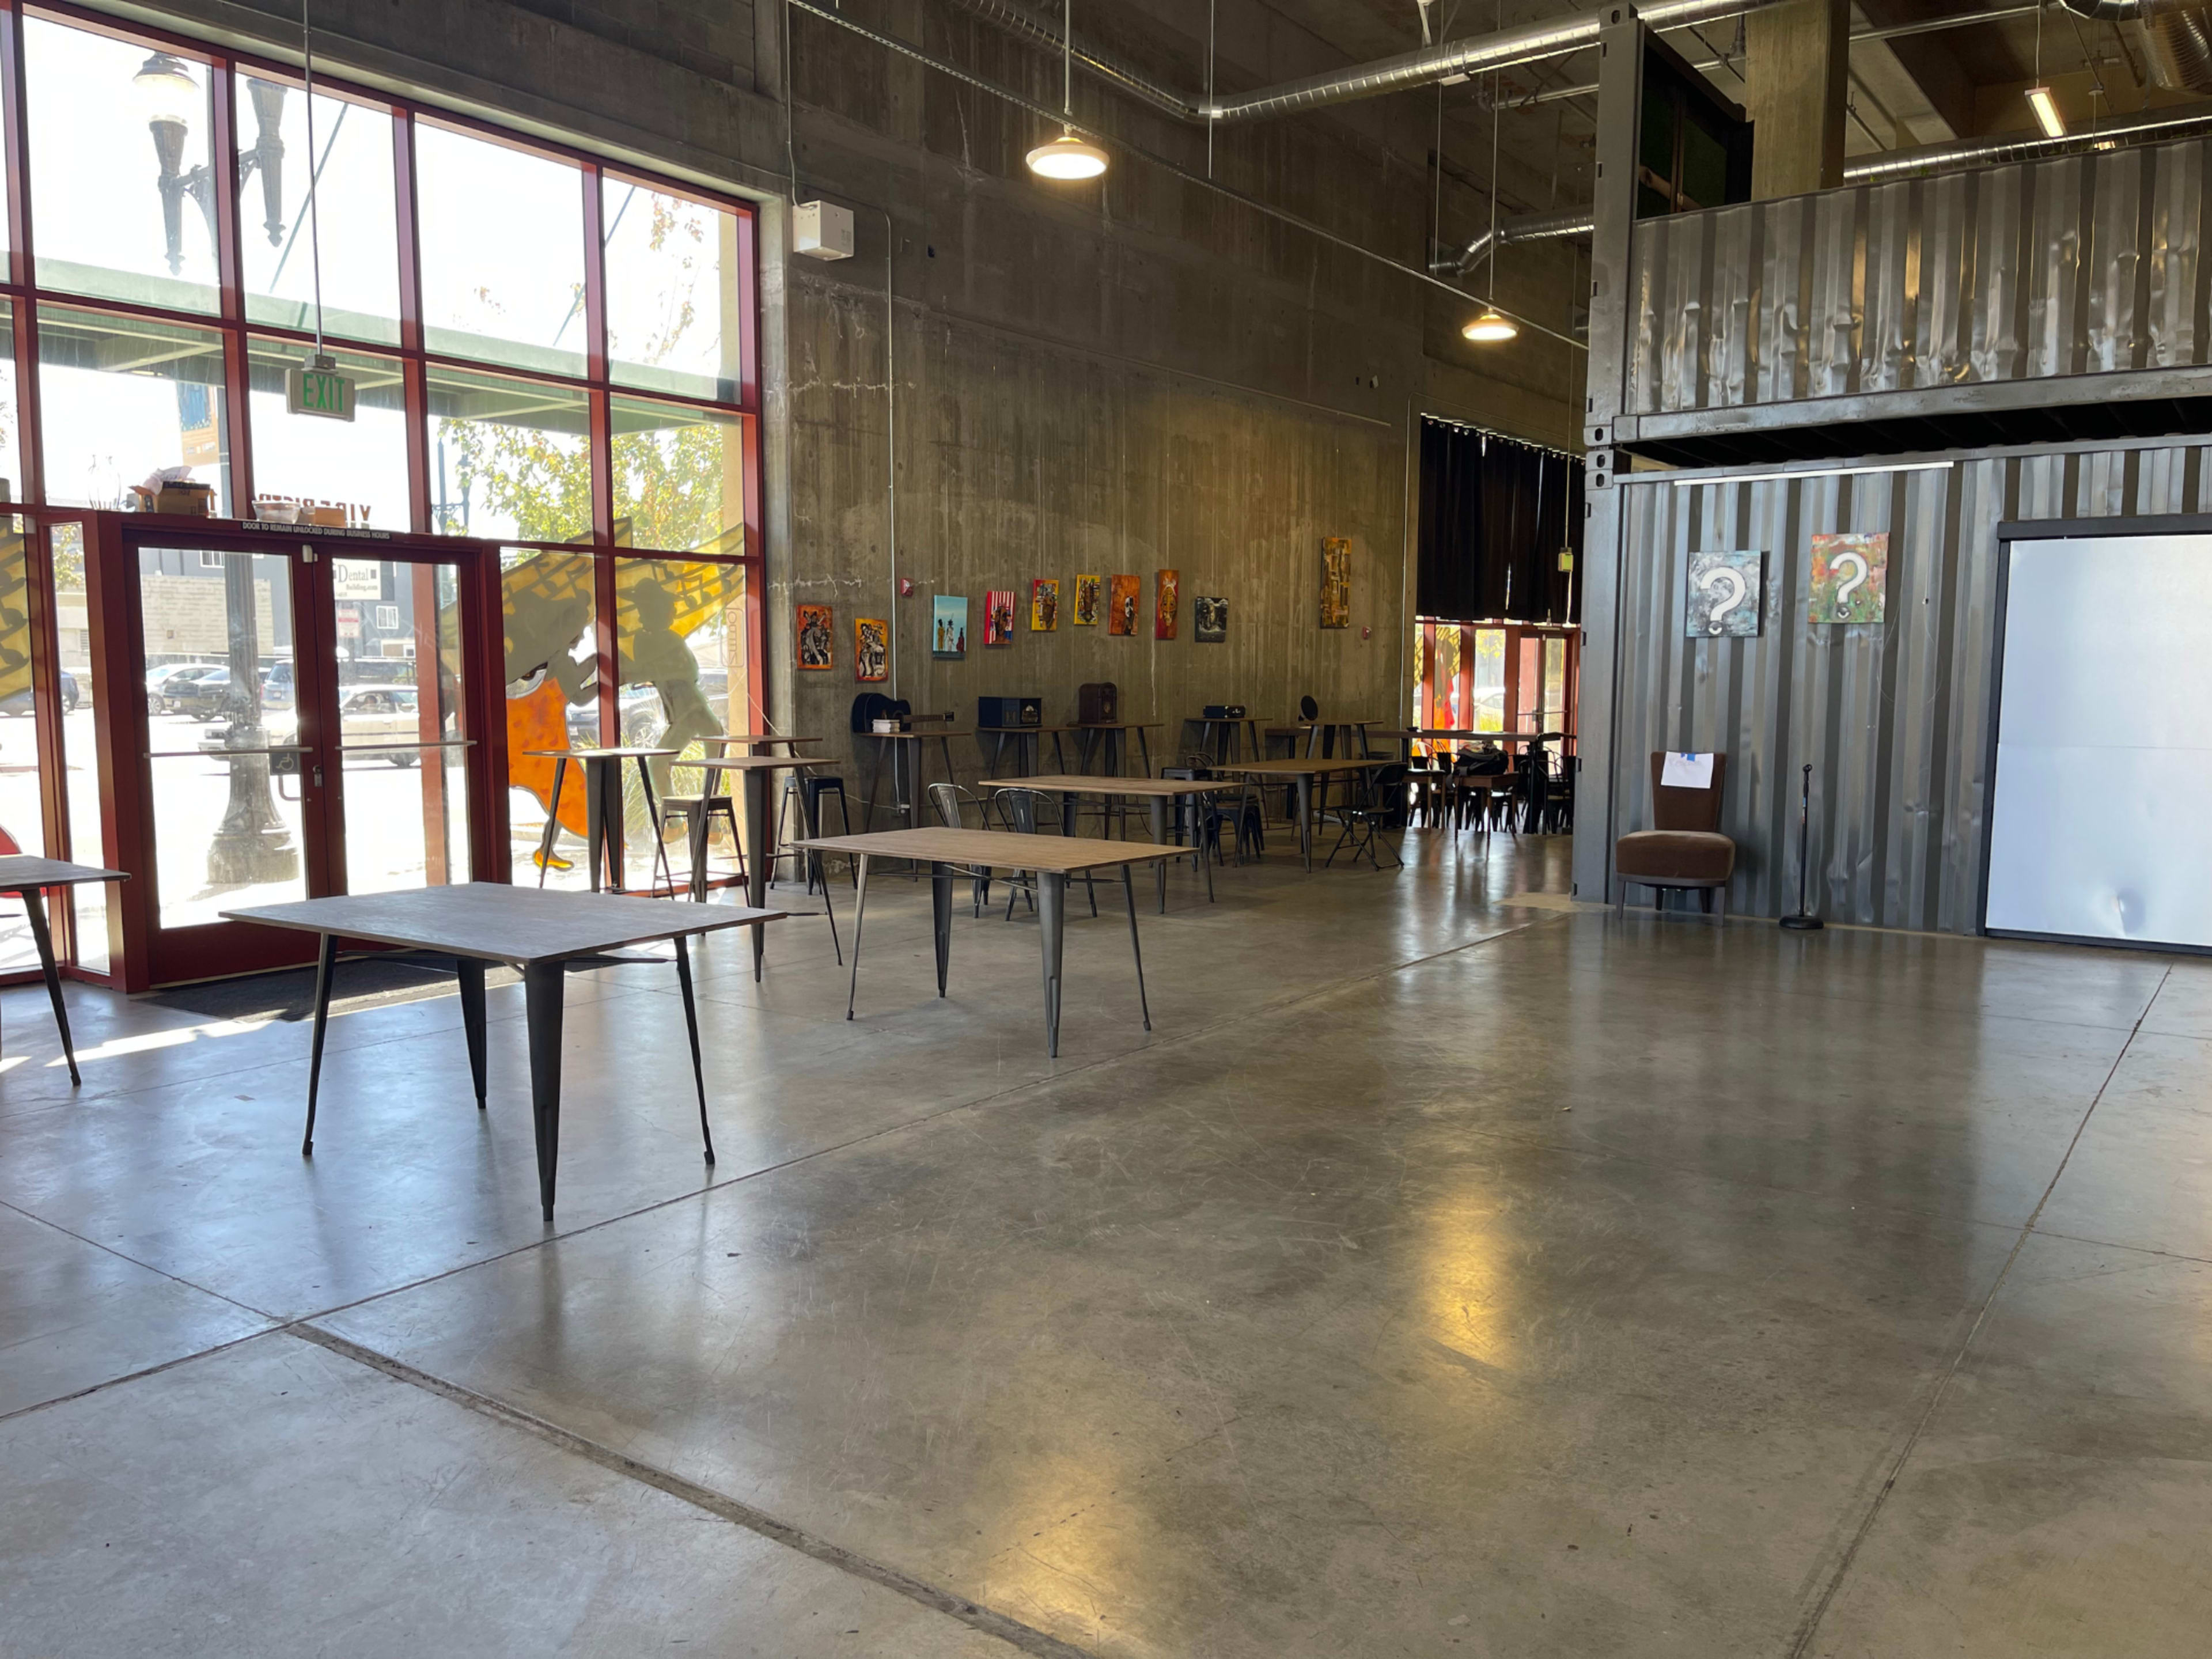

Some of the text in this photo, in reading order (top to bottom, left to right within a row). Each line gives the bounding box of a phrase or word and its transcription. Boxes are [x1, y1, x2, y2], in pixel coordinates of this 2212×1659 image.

[303, 373, 345, 412] EXIT
[243, 521, 260, 529] DOOR
[270, 524, 292, 532] REMAIN
[293, 526, 323, 535] UNLOCKED
[324, 528, 345, 536] DURING
[347, 529, 370, 538] BUSINESS
[372, 531, 390, 539] HOURS
[338, 564, 369, 583] Dental
